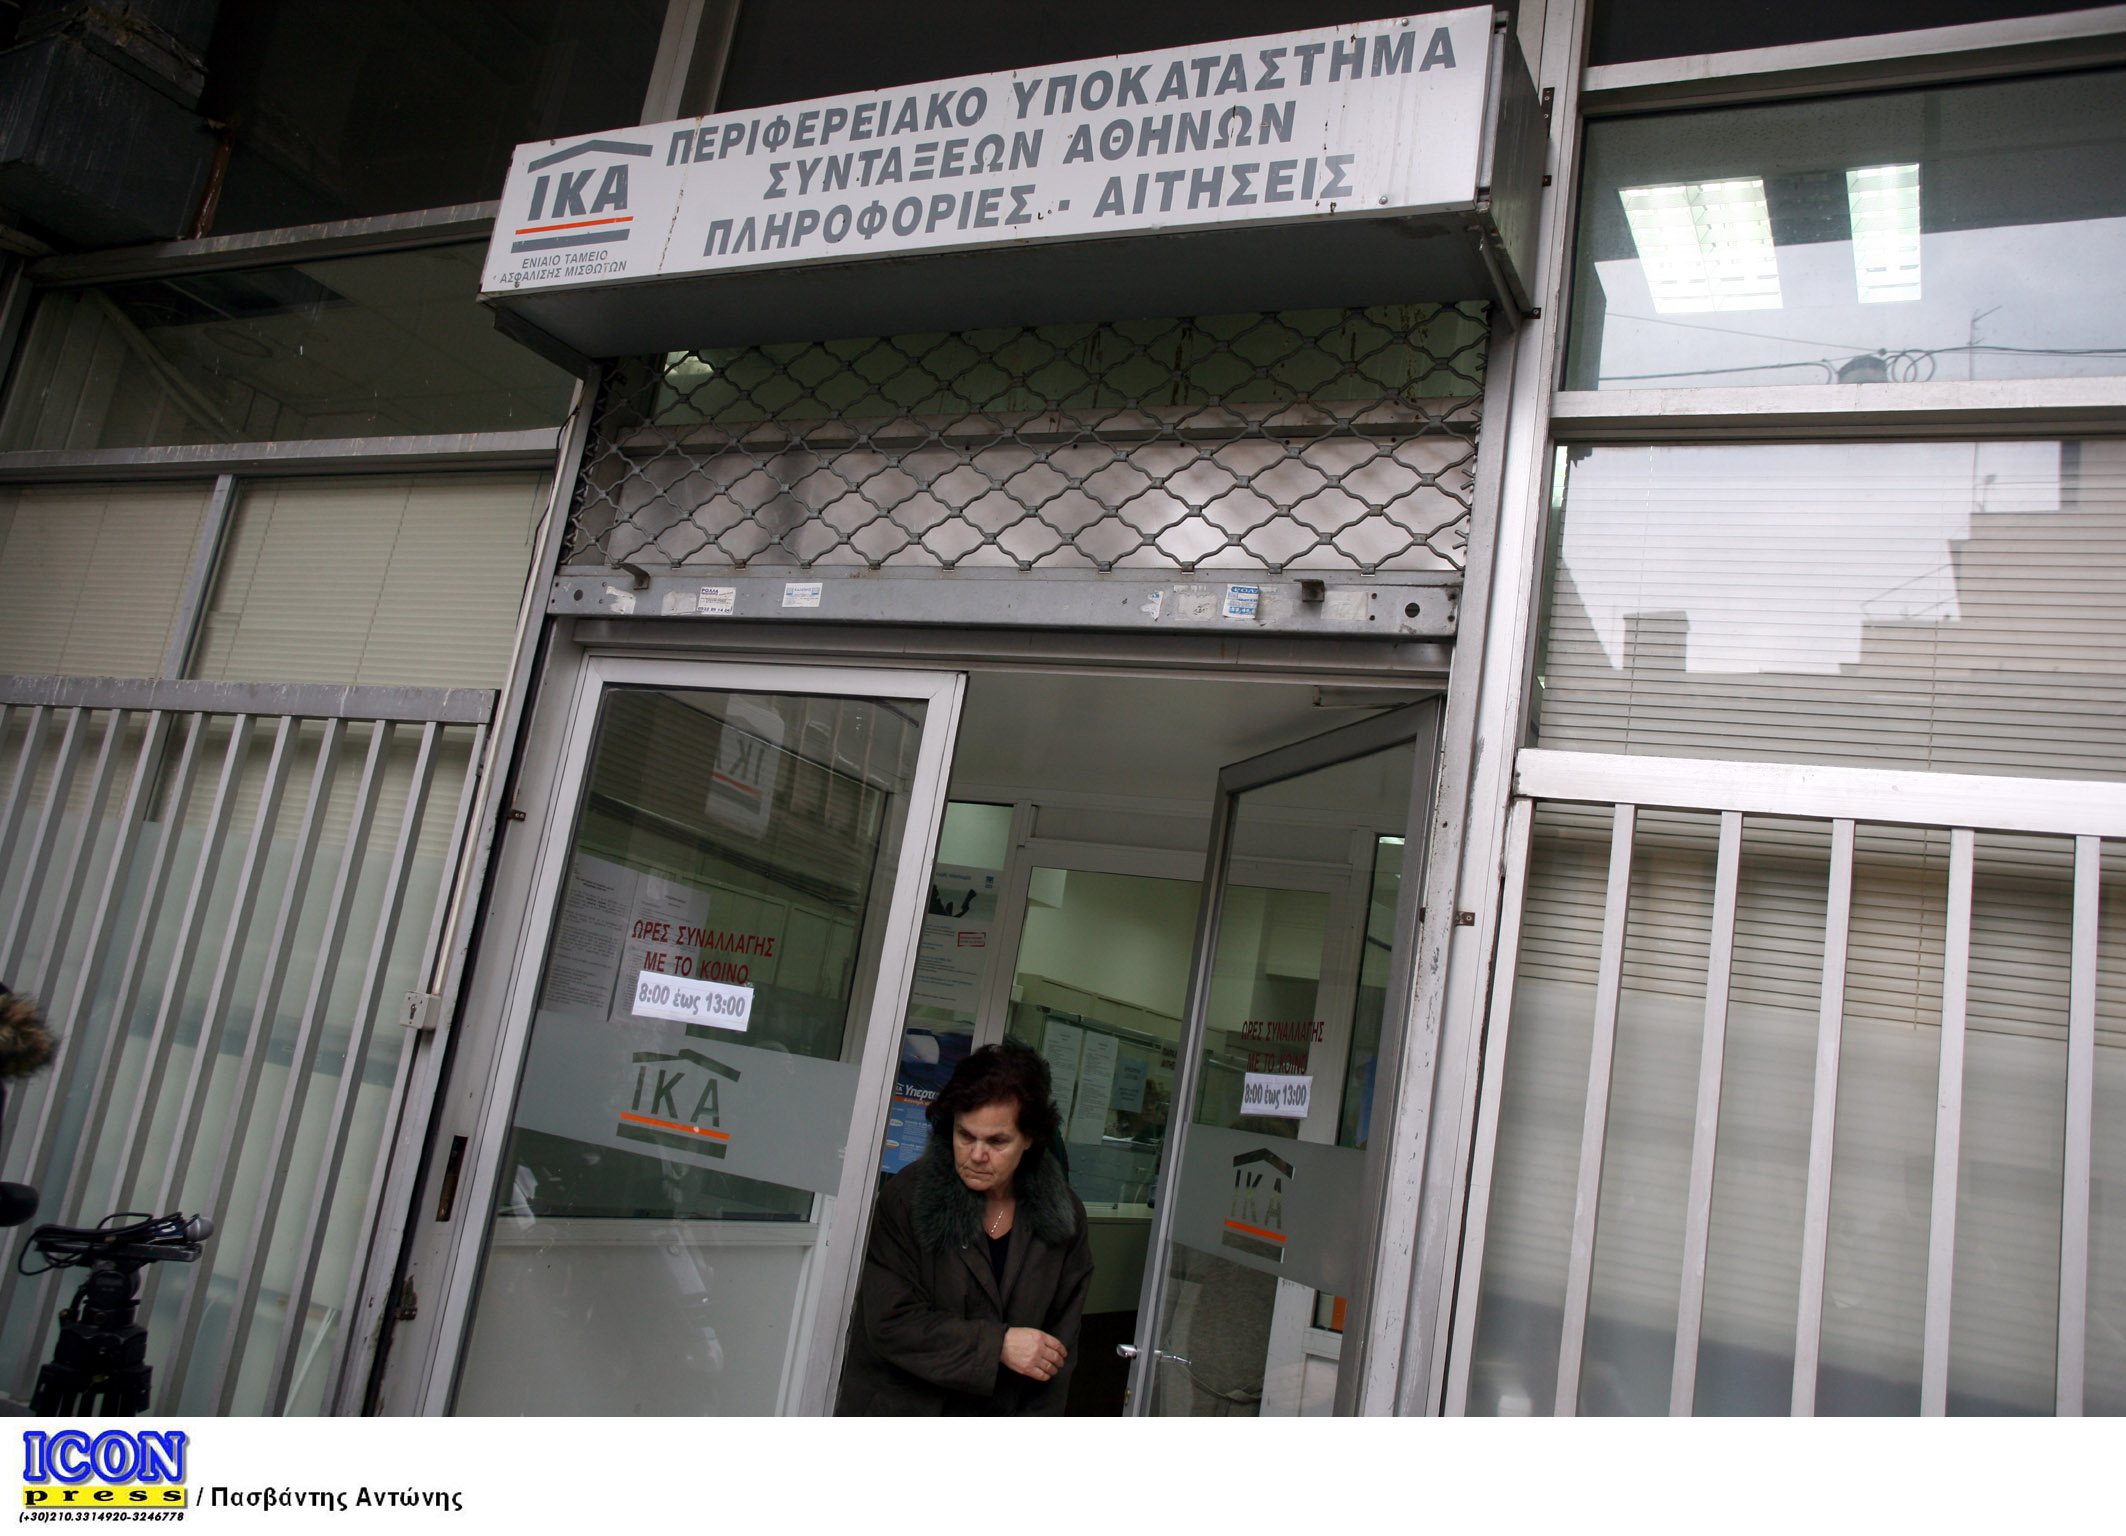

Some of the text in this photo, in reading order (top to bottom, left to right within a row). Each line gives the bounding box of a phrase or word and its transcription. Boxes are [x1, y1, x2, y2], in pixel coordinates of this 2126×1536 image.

[666, 27, 1456, 167] ΠΕΡΙΦΕΡΕΙΑΚΟ ΥΠΟΚΑΤΑΣΤΗΜΑ
[764, 101, 1297, 200] ΣΥΝΤΑΞΕΩΝ ΑΘΗΝΩΝ
[527, 164, 629, 222] ΙΚΑ
[702, 185, 1036, 257] ΠΛΗΡΟΦΟΡΙΕΣ
[1092, 154, 1356, 218] ΑΙΤΗΣΕΙΣ
[499, 260, 628, 284] ΑΣΦΑΛΙΣΗΣ ΜΙΣΘΩΤΩΝ
[521, 249, 609, 269] ΕΝΙΑΙΟ ΤΑΜΕΙΟ
[631, 919, 775, 957] ΩΡΕΣ ΣΥΝΑΛΛΑΓΗΣ
[643, 951, 749, 984] ΜΕ ΤΟ ΚΟΙΝΟ
[638, 982, 746, 1017] 8:00 έως 13:00
[1241, 1020, 1325, 1042] ΩΡΕΣ ΣΥΝΑΛΛΑΓΗΣ
[1247, 1052, 1308, 1075] ΜΕ ΤΟ ΚΟΙΝΟ
[631, 1066, 721, 1127] ΙΚΑ
[1244, 1083, 1307, 1110] 8:00 έως 13:00
